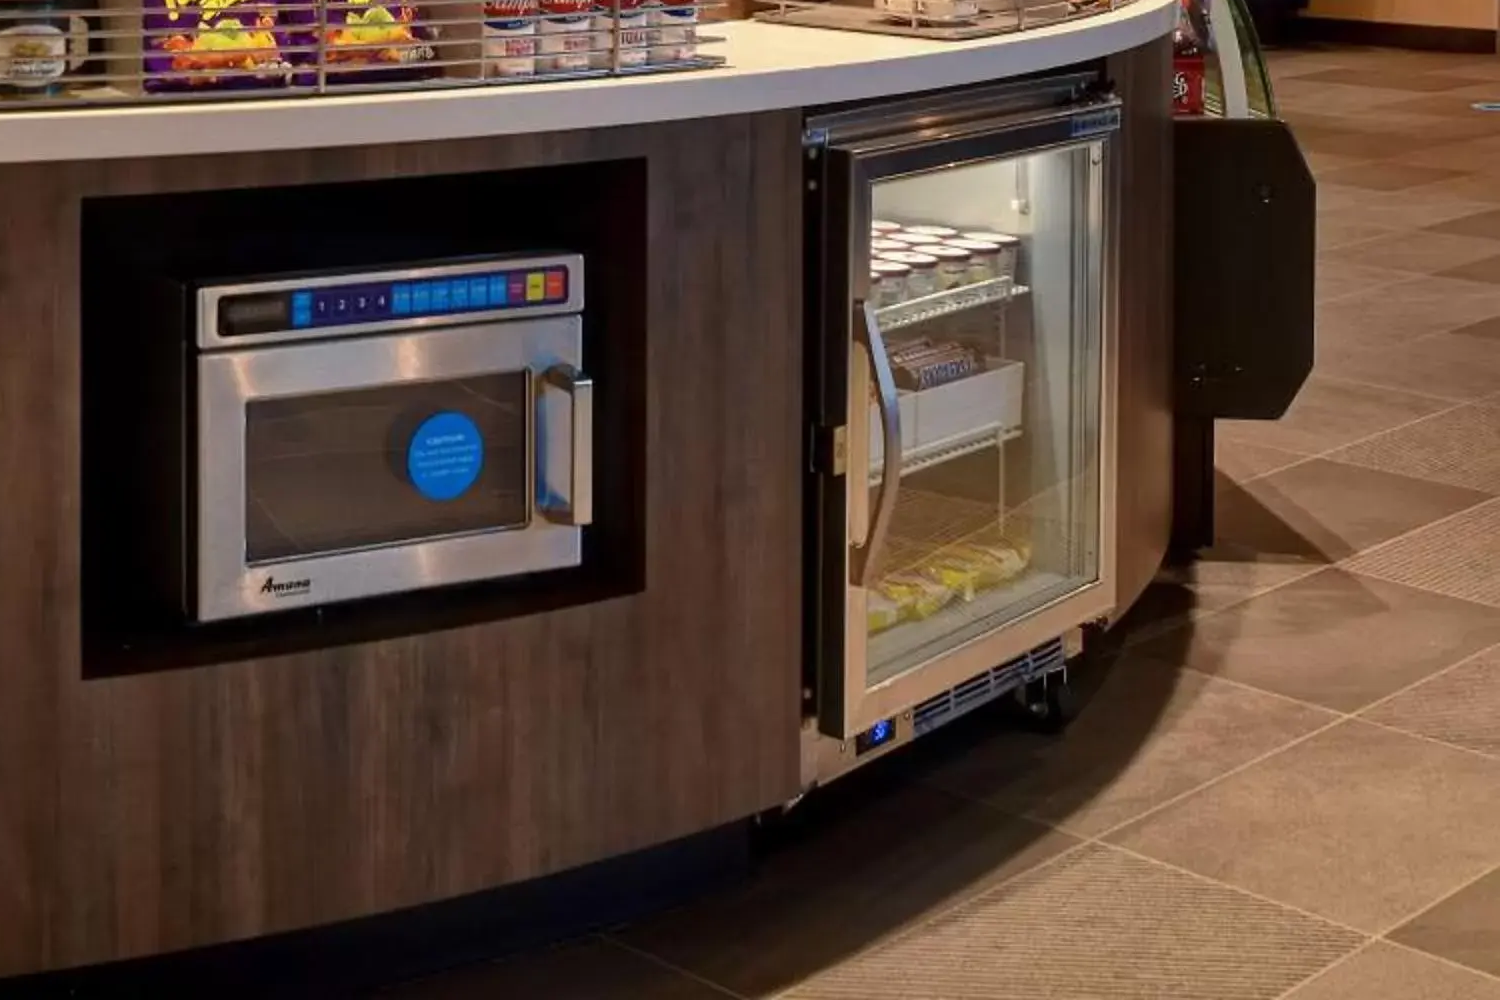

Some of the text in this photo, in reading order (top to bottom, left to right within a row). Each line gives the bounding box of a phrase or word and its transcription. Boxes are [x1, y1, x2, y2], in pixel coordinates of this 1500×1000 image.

[338, 300, 346, 311] 2
[358, 297, 366, 309] 3
[377, 295, 386, 307] 4
